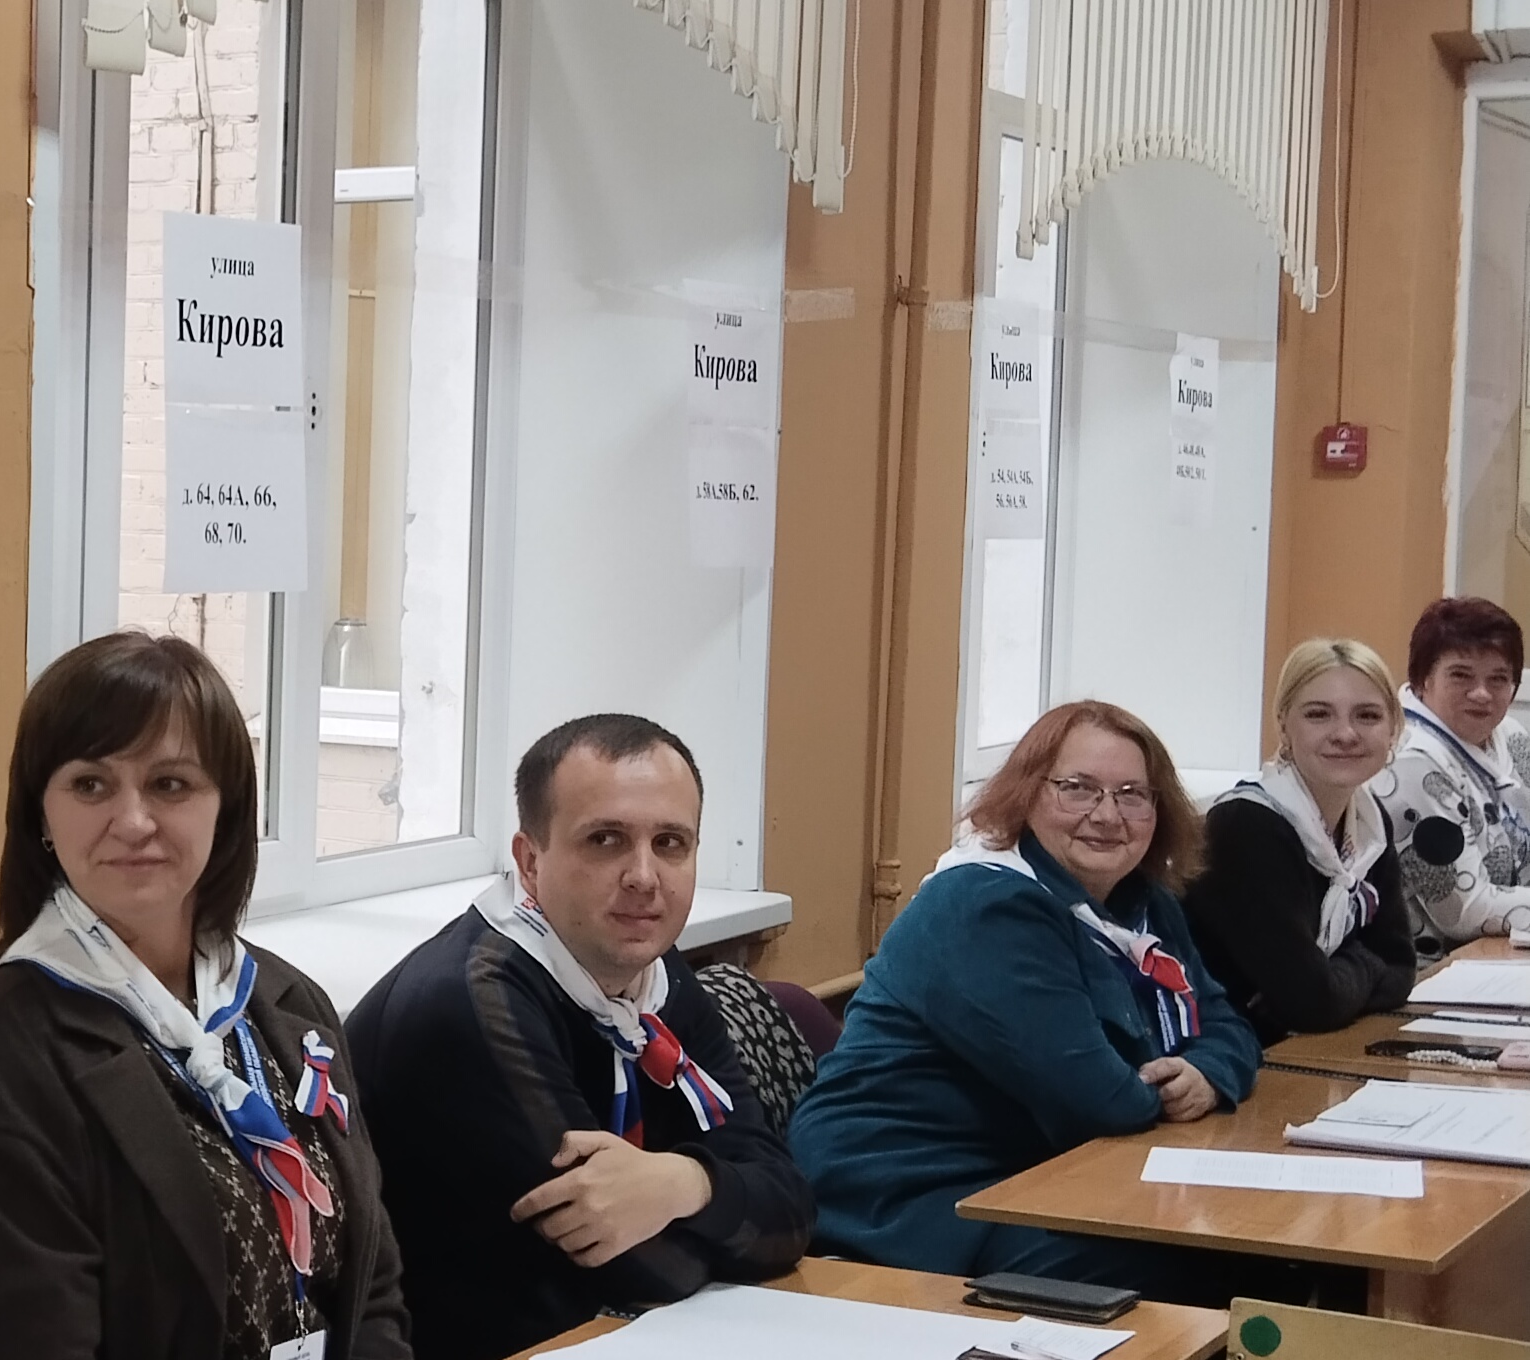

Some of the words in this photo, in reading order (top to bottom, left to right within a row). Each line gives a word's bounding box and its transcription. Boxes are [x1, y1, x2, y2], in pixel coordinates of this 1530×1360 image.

[210, 257, 255, 278] улица
[176, 298, 284, 358] Кирова
[714, 312, 742, 330] улица
[693, 343, 758, 390] Кирова
[990, 352, 1032, 389] Кирова
[1178, 379, 1213, 412] Кирова
[196, 482, 215, 509] 64,
[218, 483, 250, 511] 64А,
[254, 484, 277, 511] 66,
[204, 521, 223, 549] 68,
[227, 522, 247, 545] 70.
